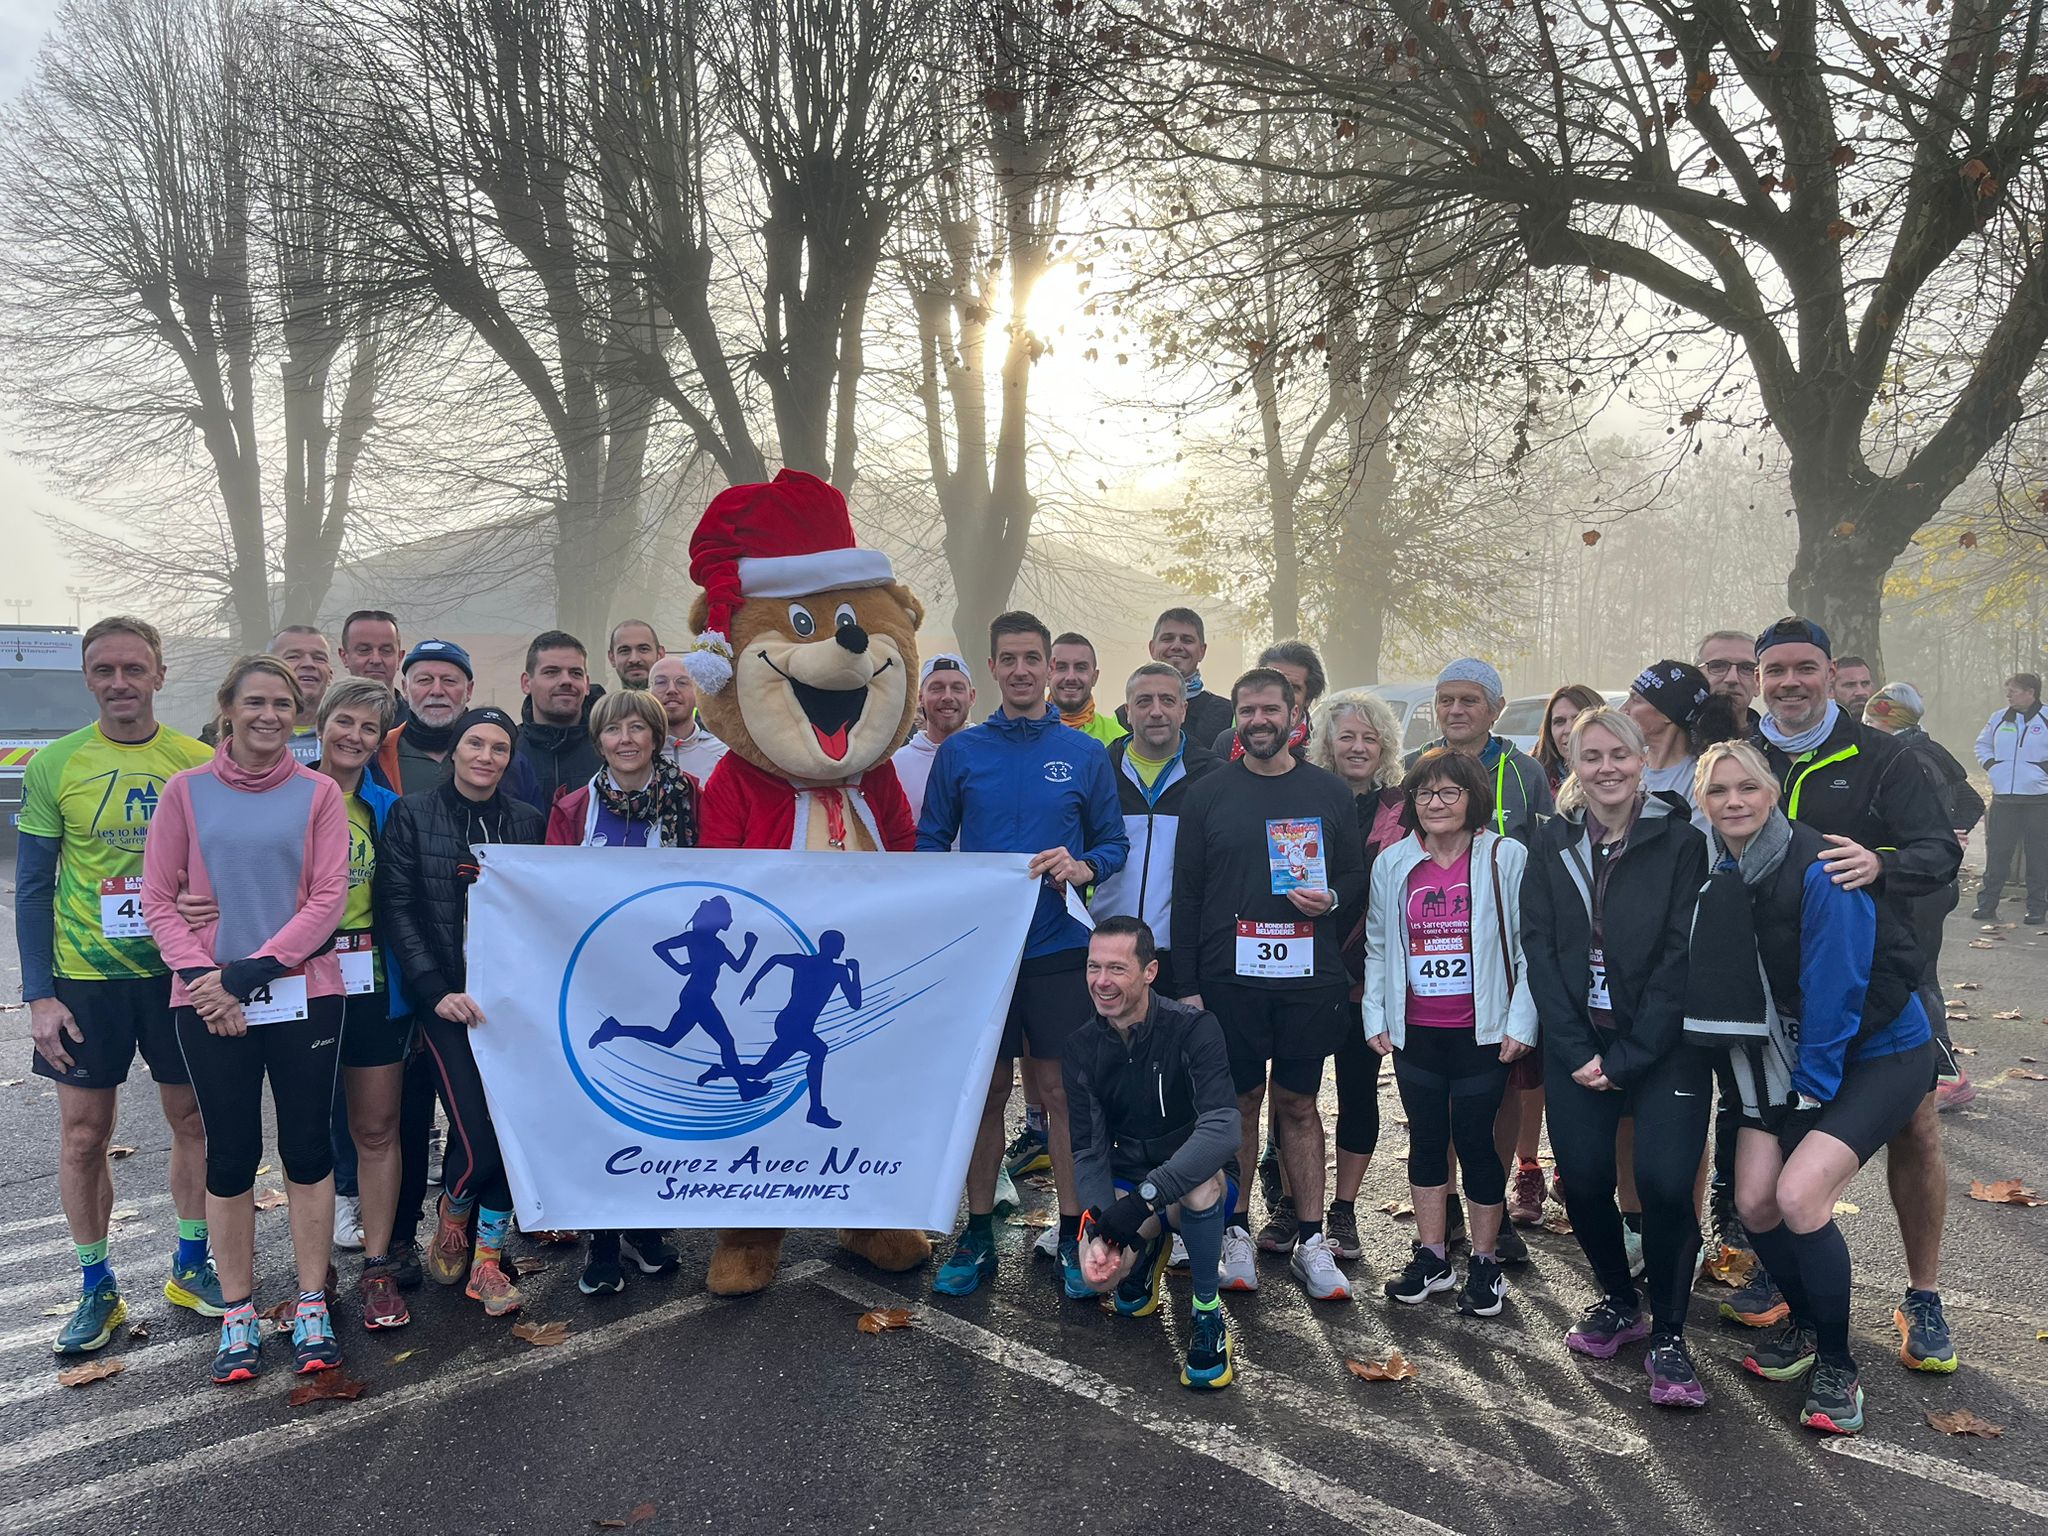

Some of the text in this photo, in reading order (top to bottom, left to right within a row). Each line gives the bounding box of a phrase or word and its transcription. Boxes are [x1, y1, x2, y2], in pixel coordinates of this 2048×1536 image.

[1264, 922, 1284, 930] RONDE
[1410, 922, 1421, 930] Les
[1257, 942, 1288, 961] 30
[1420, 958, 1467, 979] 482
[605, 1145, 902, 1176] Courez Avec Nous
